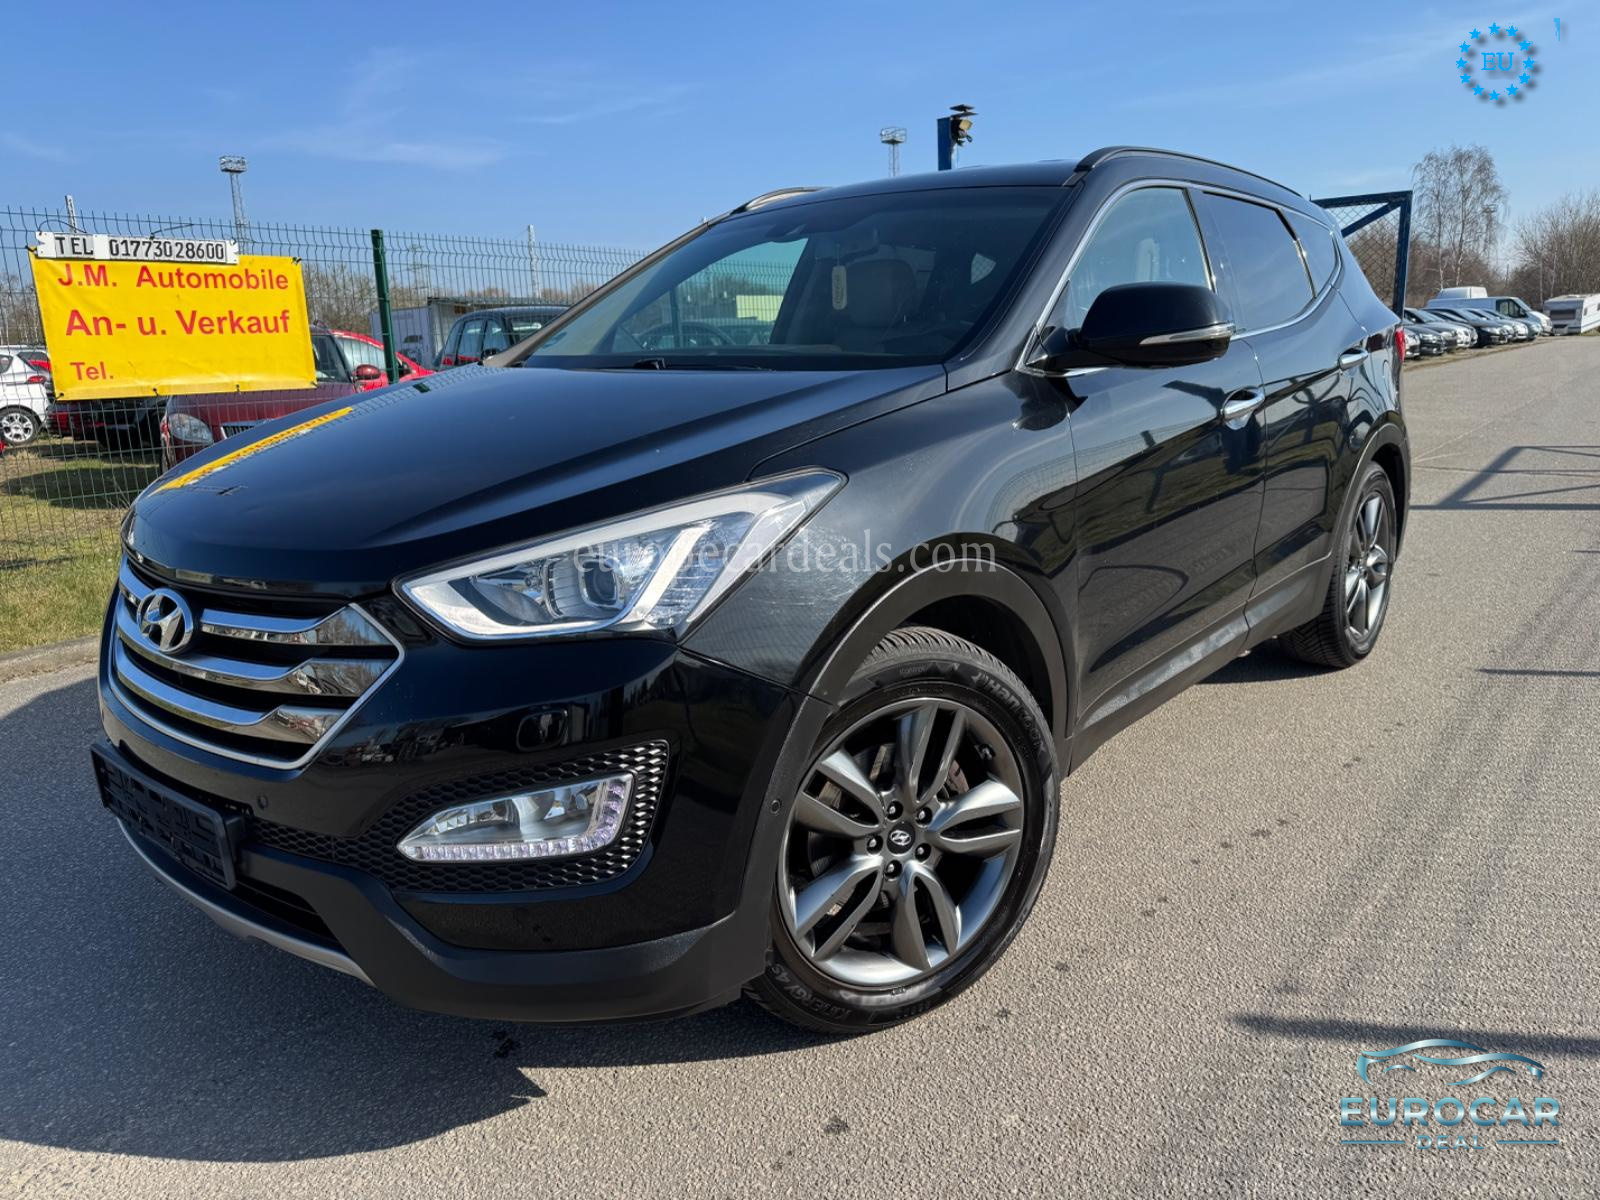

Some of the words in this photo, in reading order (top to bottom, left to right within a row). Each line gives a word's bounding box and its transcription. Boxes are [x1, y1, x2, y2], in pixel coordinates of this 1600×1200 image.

[55, 236, 94, 256] TEL
[109, 239, 225, 260] 01773028600
[58, 264, 117, 287] J.M.
[136, 265, 289, 290] Automobile
[66, 309, 127, 336] An-
[138, 314, 167, 336] u.
[176, 309, 290, 335] Verkauf
[70, 361, 114, 381] Tel.
